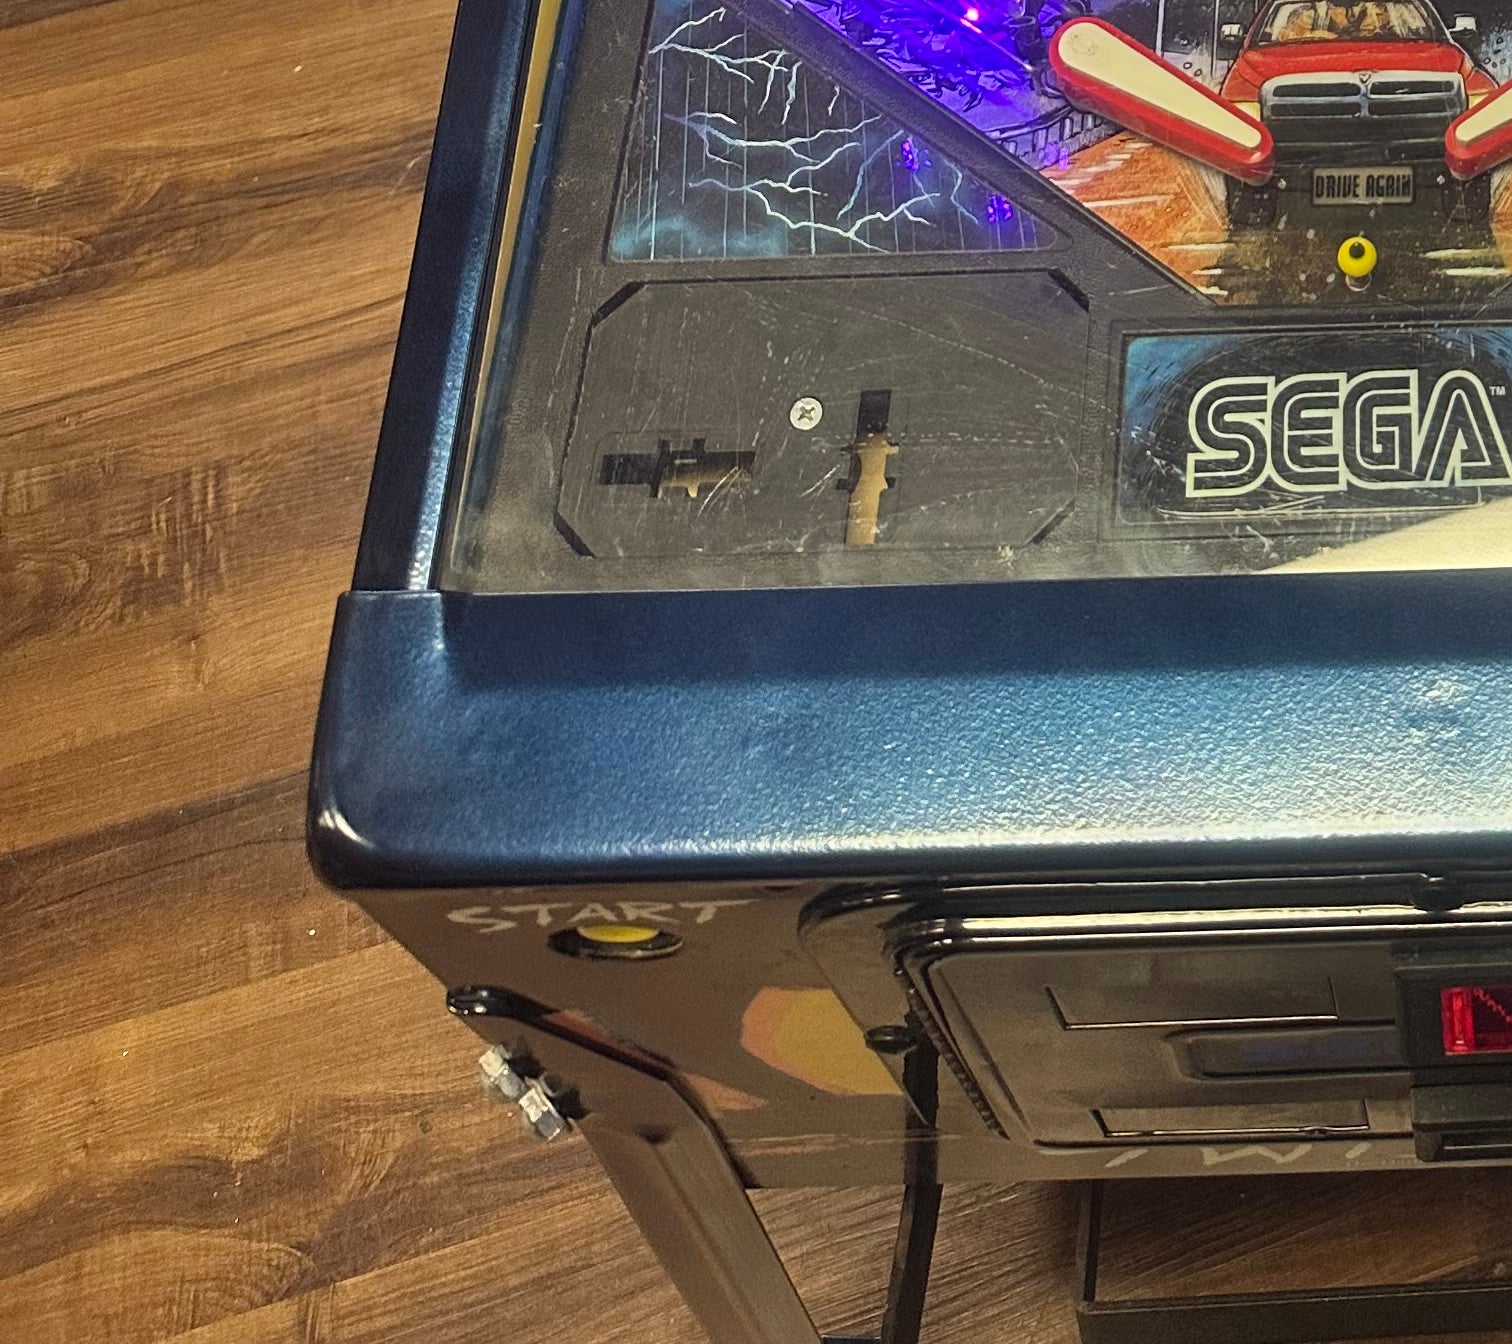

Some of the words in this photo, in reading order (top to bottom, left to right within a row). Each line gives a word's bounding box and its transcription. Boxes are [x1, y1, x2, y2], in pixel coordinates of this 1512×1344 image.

[1315, 174, 1360, 198] DRIVE
[1365, 174, 1411, 198] AGAIN
[1490, 385, 1506, 396] TM
[446, 898, 762, 934] START
